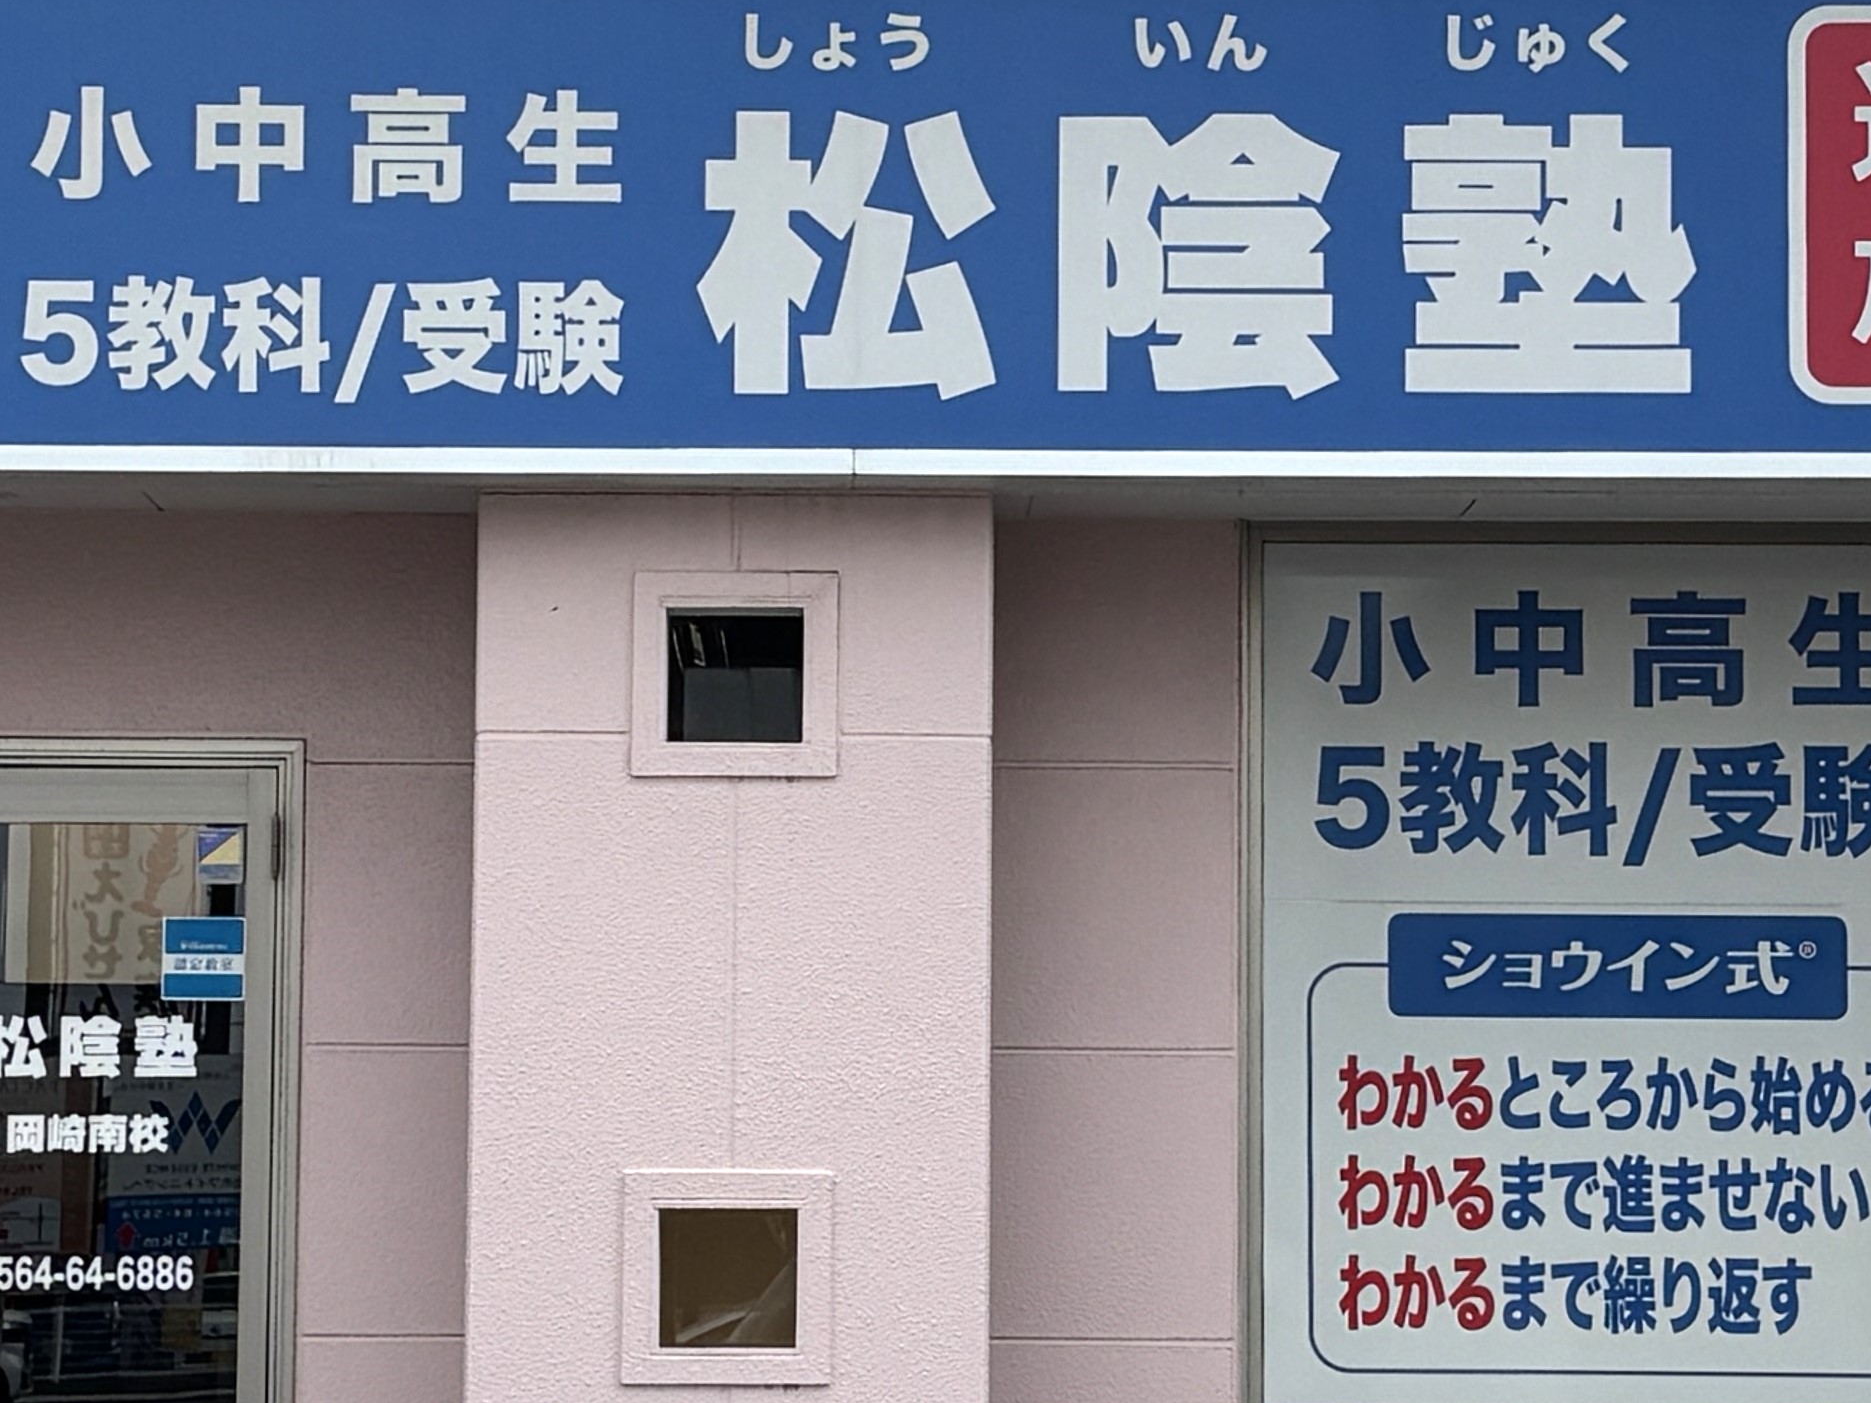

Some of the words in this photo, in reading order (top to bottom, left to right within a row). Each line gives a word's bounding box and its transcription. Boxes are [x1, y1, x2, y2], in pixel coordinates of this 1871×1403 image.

[744, 12, 931, 72] しょう
[1133, 13, 1268, 72] いん
[1446, 12, 1630, 74] じゅく
[30, 85, 623, 203] 小中高生
[695, 109, 1698, 402] 松陰塾
[20, 275, 626, 404] 5教科/受験
[5, 1113, 170, 1154] 岡崎南校
[1338, 1154, 1871, 1236] わかるまで進ませない
[1338, 1254, 1814, 1336] わかるまで繰り返す
